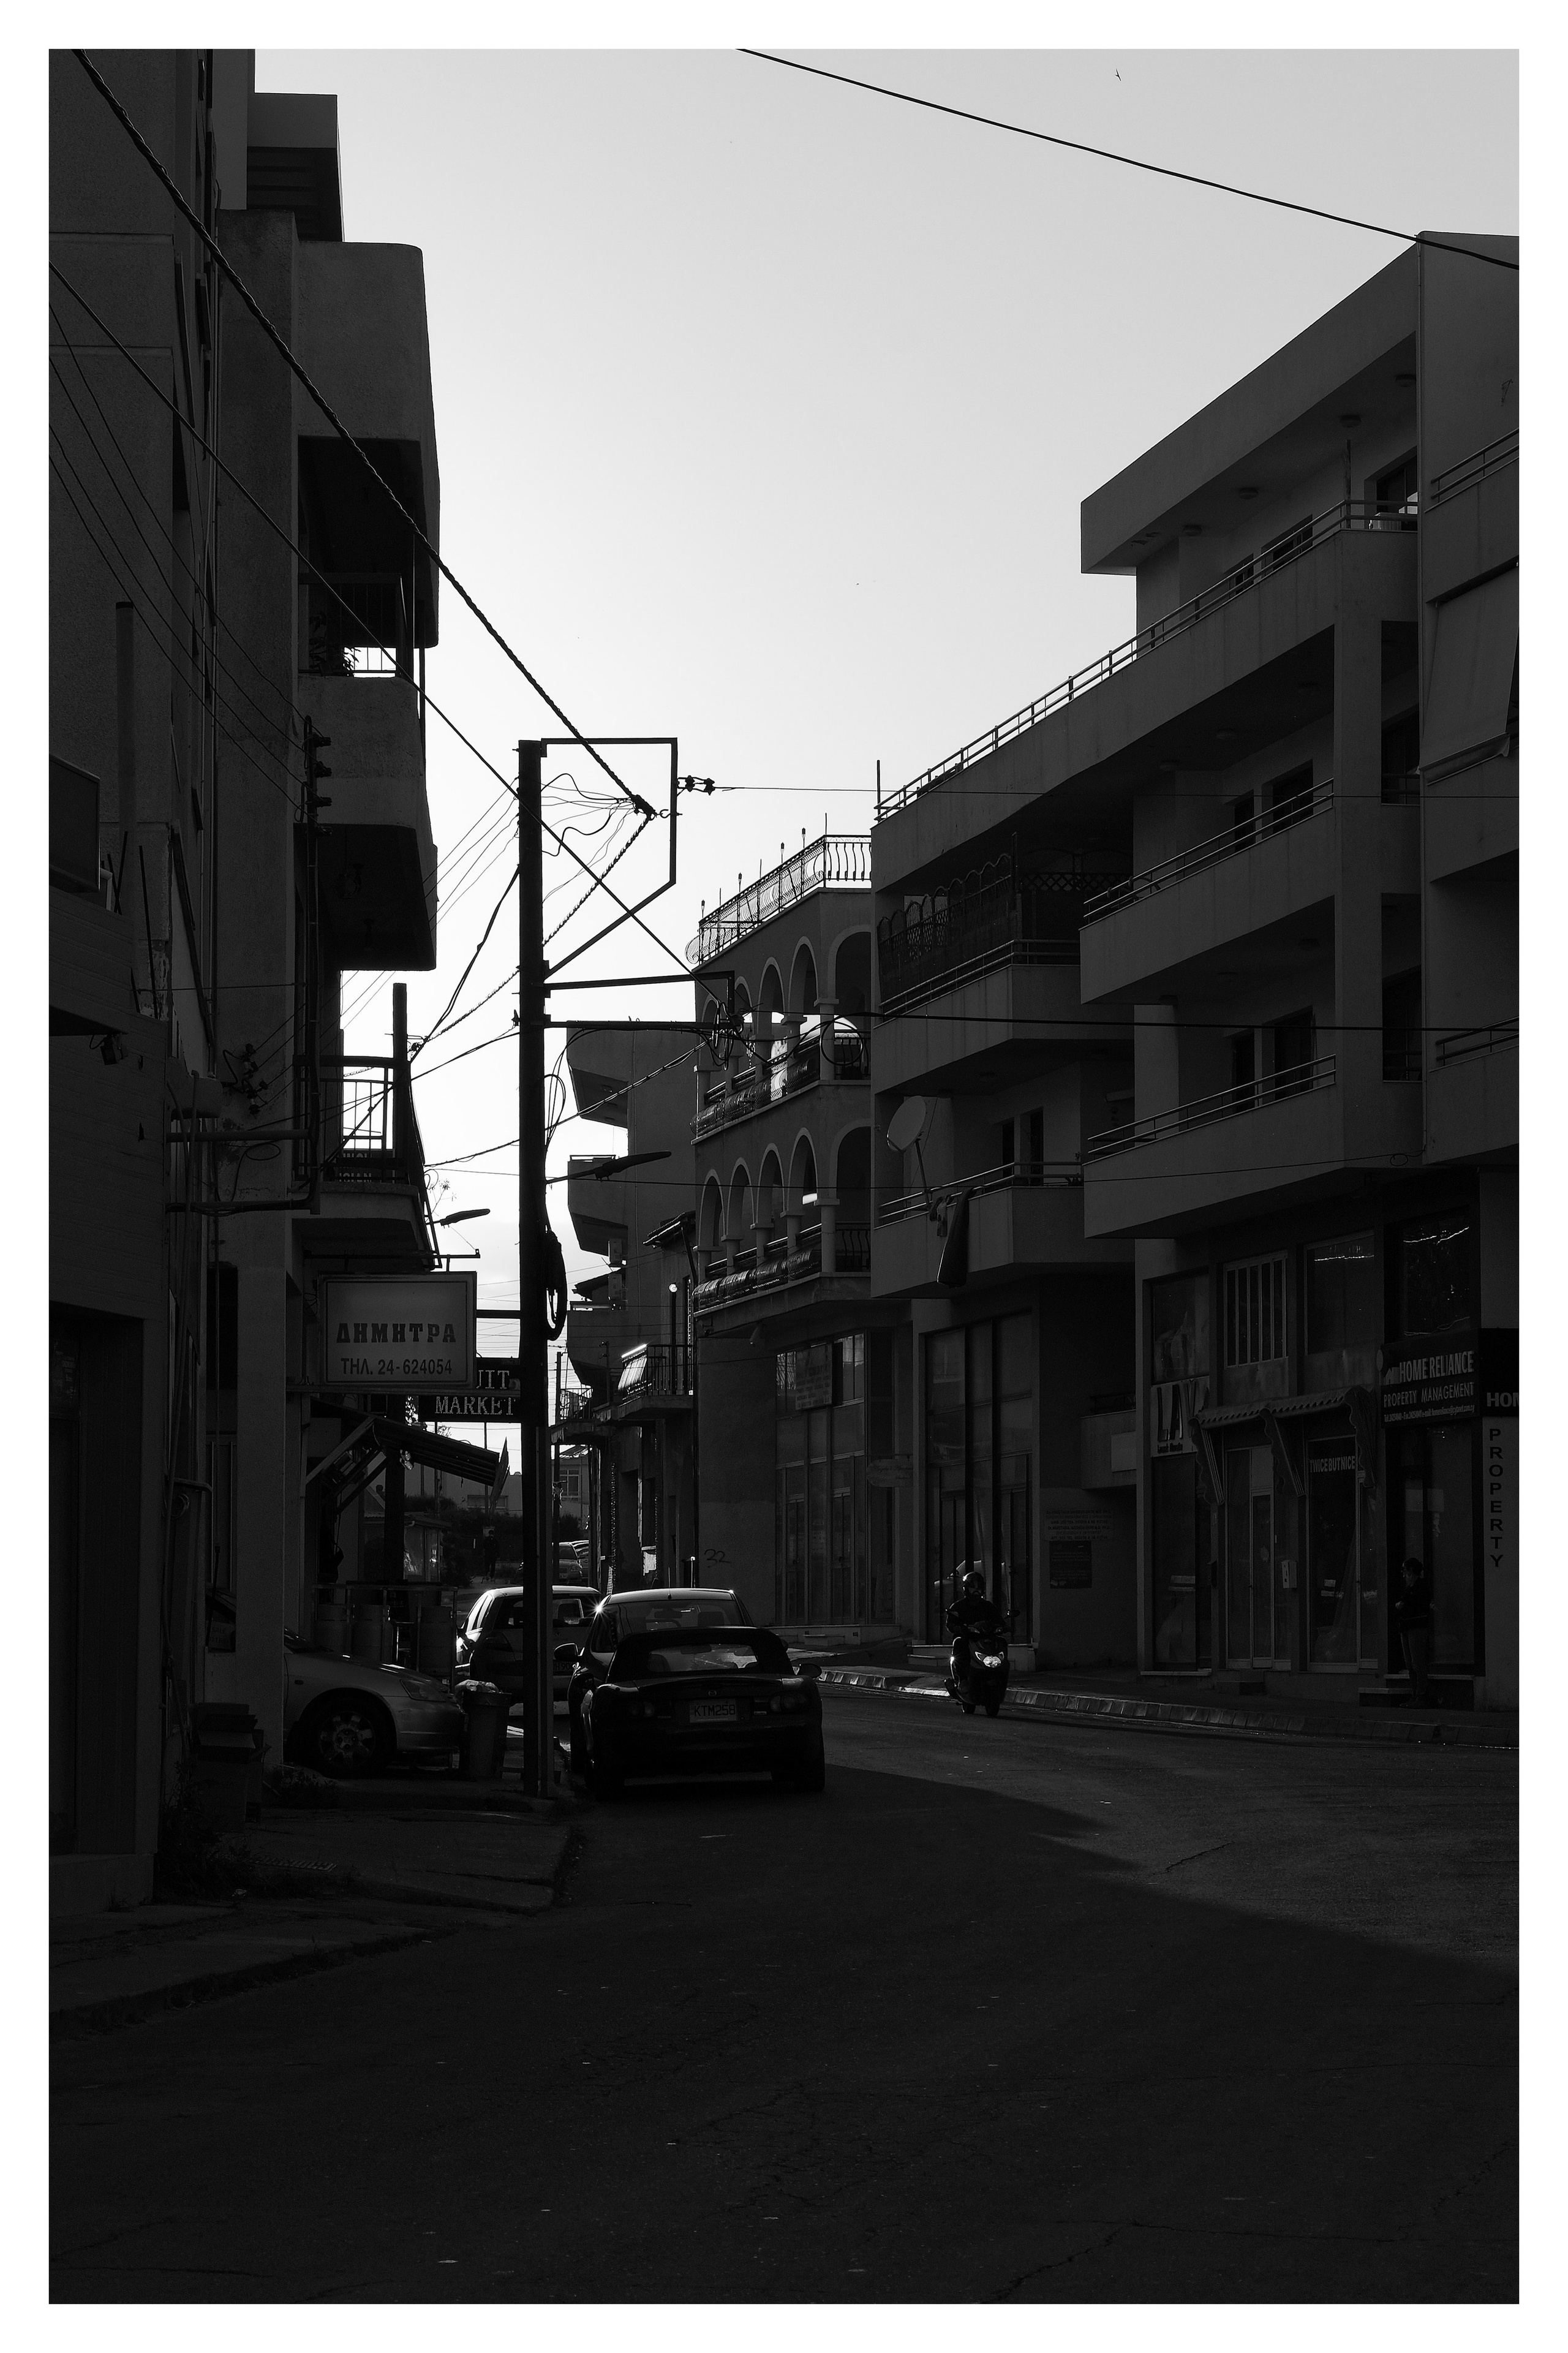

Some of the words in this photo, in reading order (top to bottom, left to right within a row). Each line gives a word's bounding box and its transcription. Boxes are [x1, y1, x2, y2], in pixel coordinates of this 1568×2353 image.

[337, 1323, 456, 1343] ΔΗΜΗΤΡΑ
[341, 1358, 373, 1375] ΤΗΛ.
[377, 1358, 452, 1375] 24-624054
[1400, 1358, 1428, 1383] HOME
[1430, 1351, 1474, 1378] RELIANCE
[1384, 1390, 1417, 1408] PROPERTY
[1421, 1382, 1474, 1403] MANAGEMENT
[434, 1396, 516, 1416] MARKET
[1488, 1428, 1504, 1568] PROPERTY
[694, 1704, 736, 1717] KTM258
